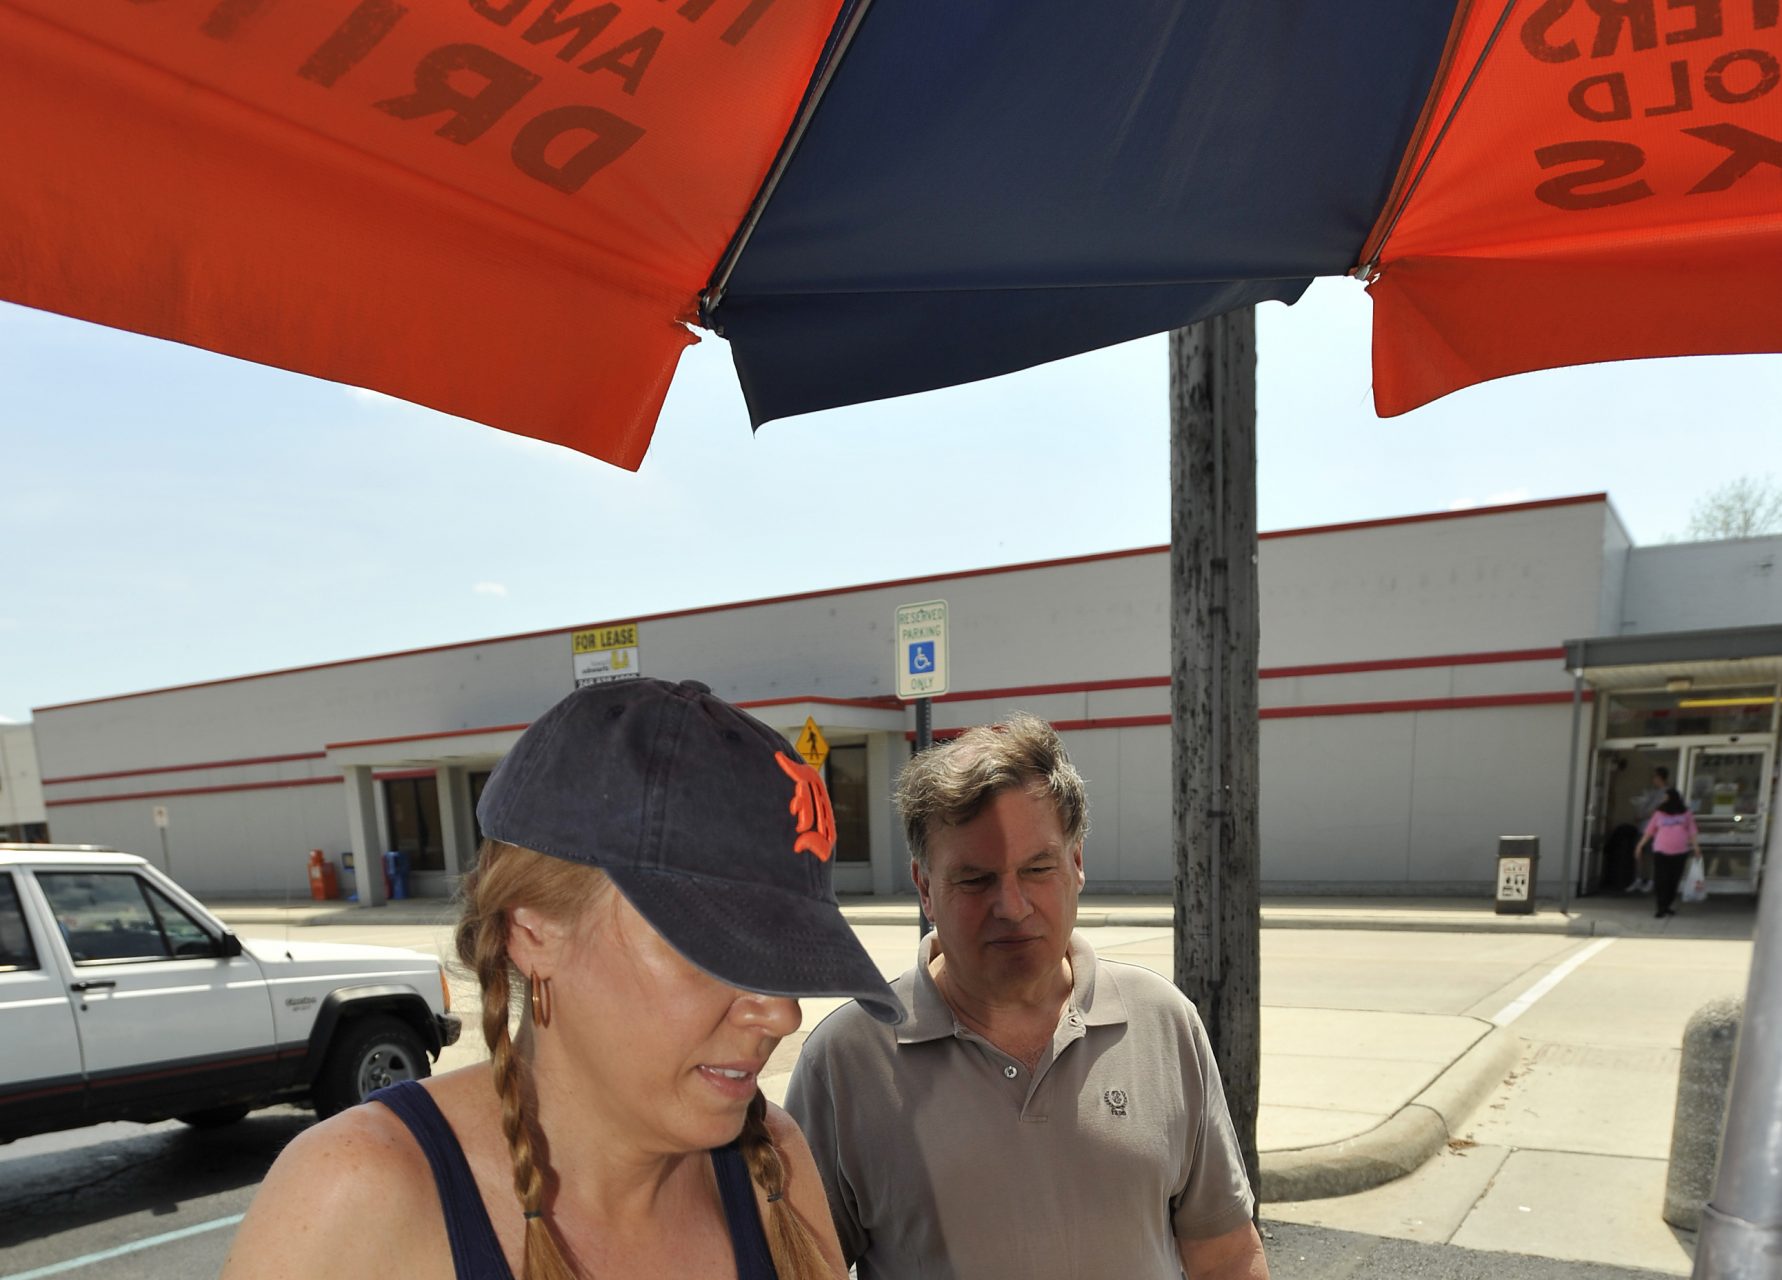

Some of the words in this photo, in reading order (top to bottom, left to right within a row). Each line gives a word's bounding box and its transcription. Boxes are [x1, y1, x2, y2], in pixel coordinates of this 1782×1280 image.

[898, 608, 944, 624] RESERVED
[902, 624, 942, 639] PARKING
[575, 633, 596, 651] FOR
[600, 628, 635, 648] LEASE
[911, 676, 933, 691] ONLY
